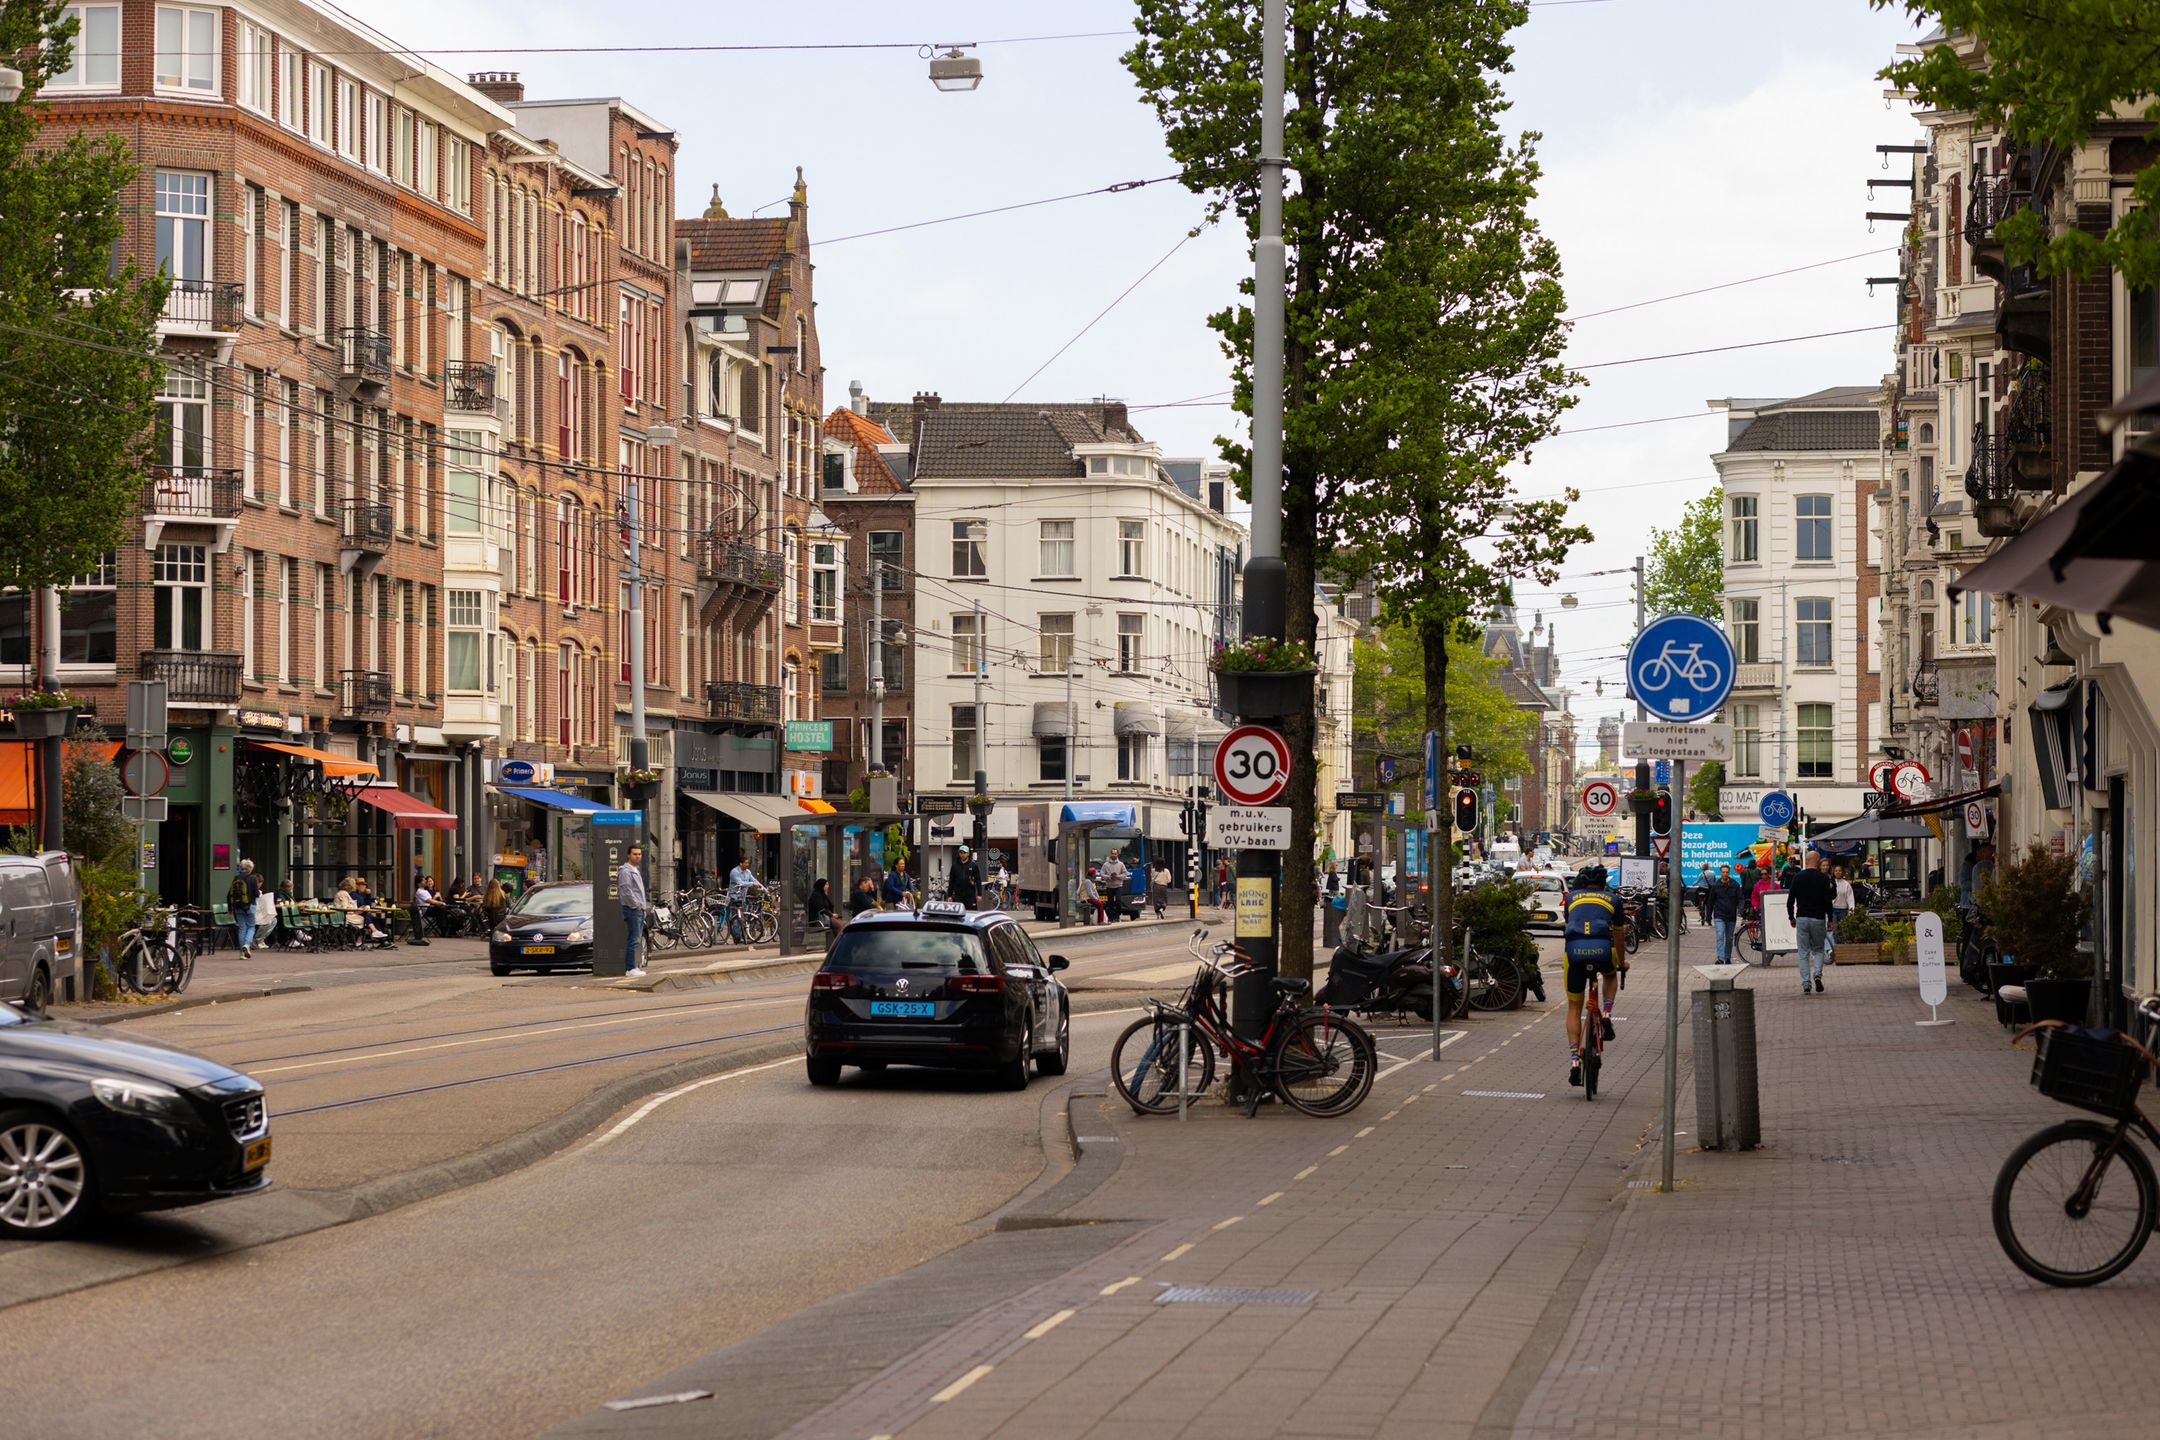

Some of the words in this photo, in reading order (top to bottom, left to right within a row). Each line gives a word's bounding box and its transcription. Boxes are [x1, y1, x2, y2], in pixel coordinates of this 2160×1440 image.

[789, 723, 829, 732] PRINCESS
[1647, 726, 1706, 734] snorfietsen
[789, 732, 829, 743] HOSTEL
[1649, 747, 1706, 756] toegestaan
[1229, 750, 1276, 780] 30
[513, 767, 534, 775] Primera
[682, 770, 708, 780] Janus
[1589, 792, 1611, 806] 30
[1736, 791, 1760, 803] MAT
[1230, 810, 1267, 818] m.u.v.
[1970, 811, 1979, 820] 30
[1219, 822, 1283, 833] gebruikers
[1681, 831, 1703, 839] Deze
[1224, 835, 1276, 846] OV-baan
[1681, 840, 1728, 850] bezorgbus
[1681, 850, 1689, 858] is
[1691, 850, 1732, 858] helemaal
[930, 903, 960, 912] TAXI
[1924, 928, 1934, 937] &
[1573, 947, 1604, 956] LEGEND
[877, 1003, 928, 1014] GSK-25-X
